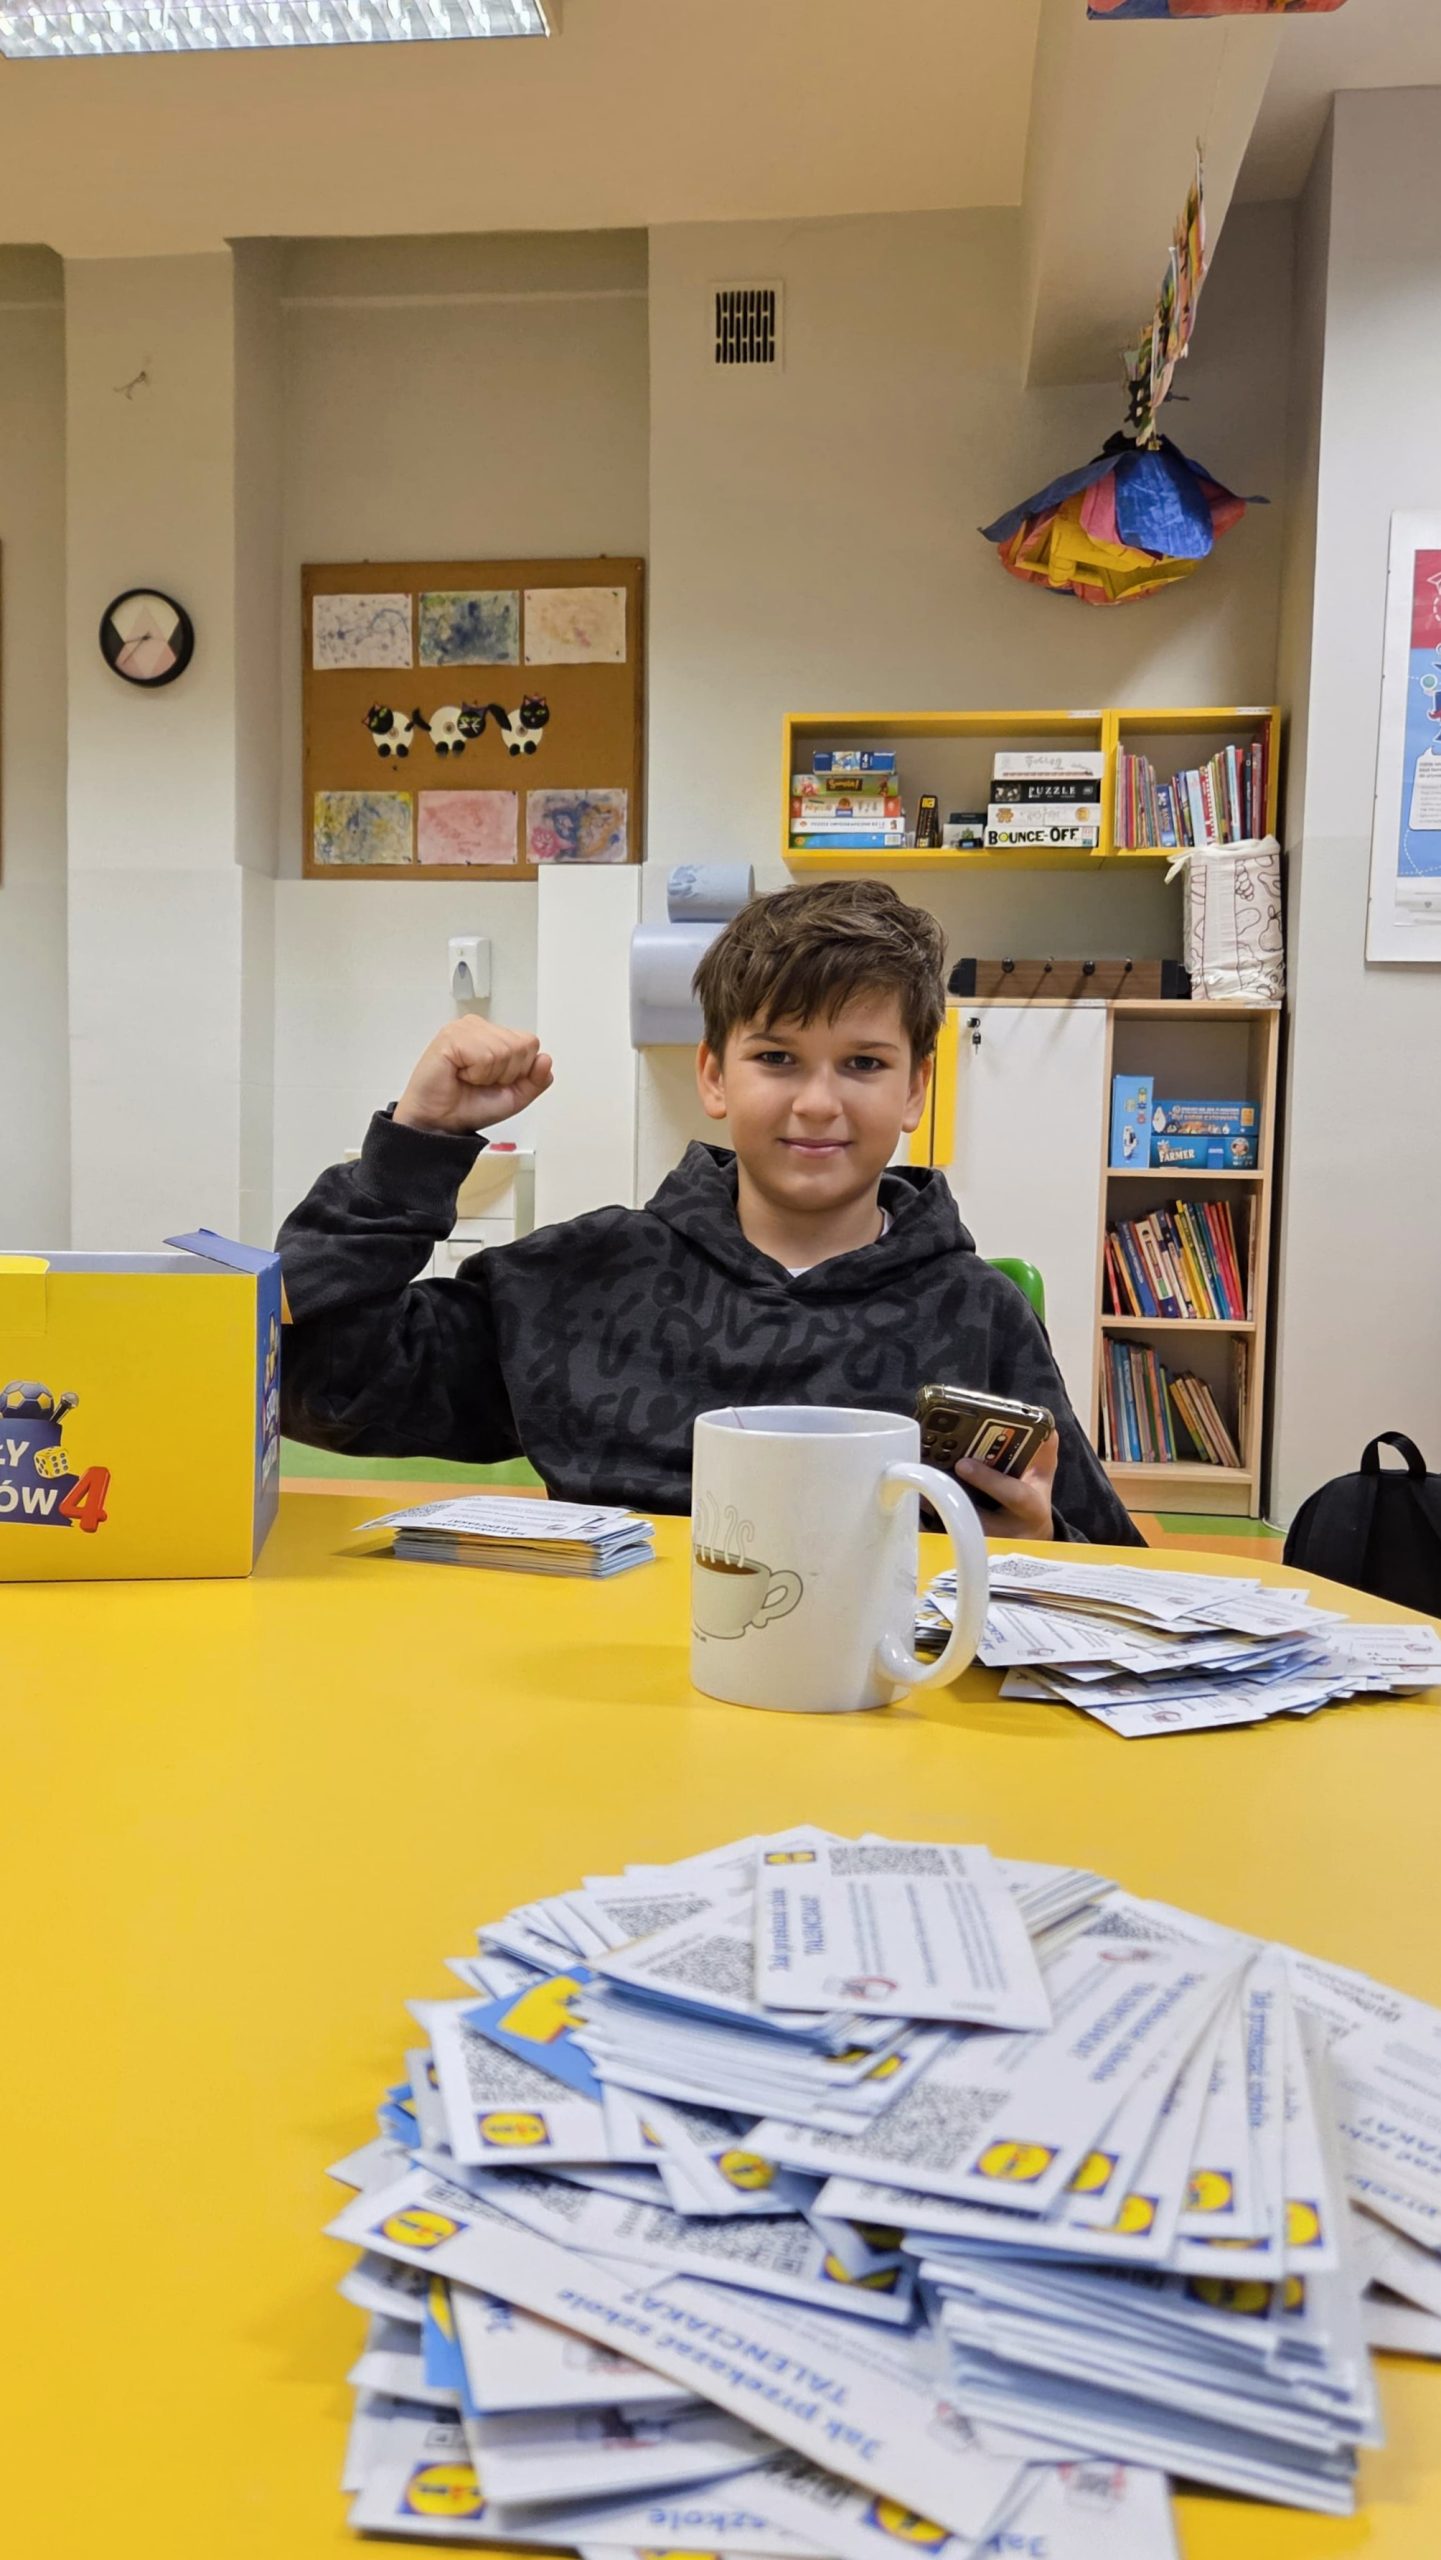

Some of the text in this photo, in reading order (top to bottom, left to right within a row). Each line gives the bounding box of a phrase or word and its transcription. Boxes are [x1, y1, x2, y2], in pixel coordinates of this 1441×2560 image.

[1028, 786, 1076, 797] PUZZLE
[1159, 1148, 1195, 1163] FARMER
[557, 2289, 652, 2336] szkole
[620, 2292, 846, 2404] TALENCIAKA?
[656, 2333, 818, 2421] przekazać
[826, 2416, 880, 2461] Jak
